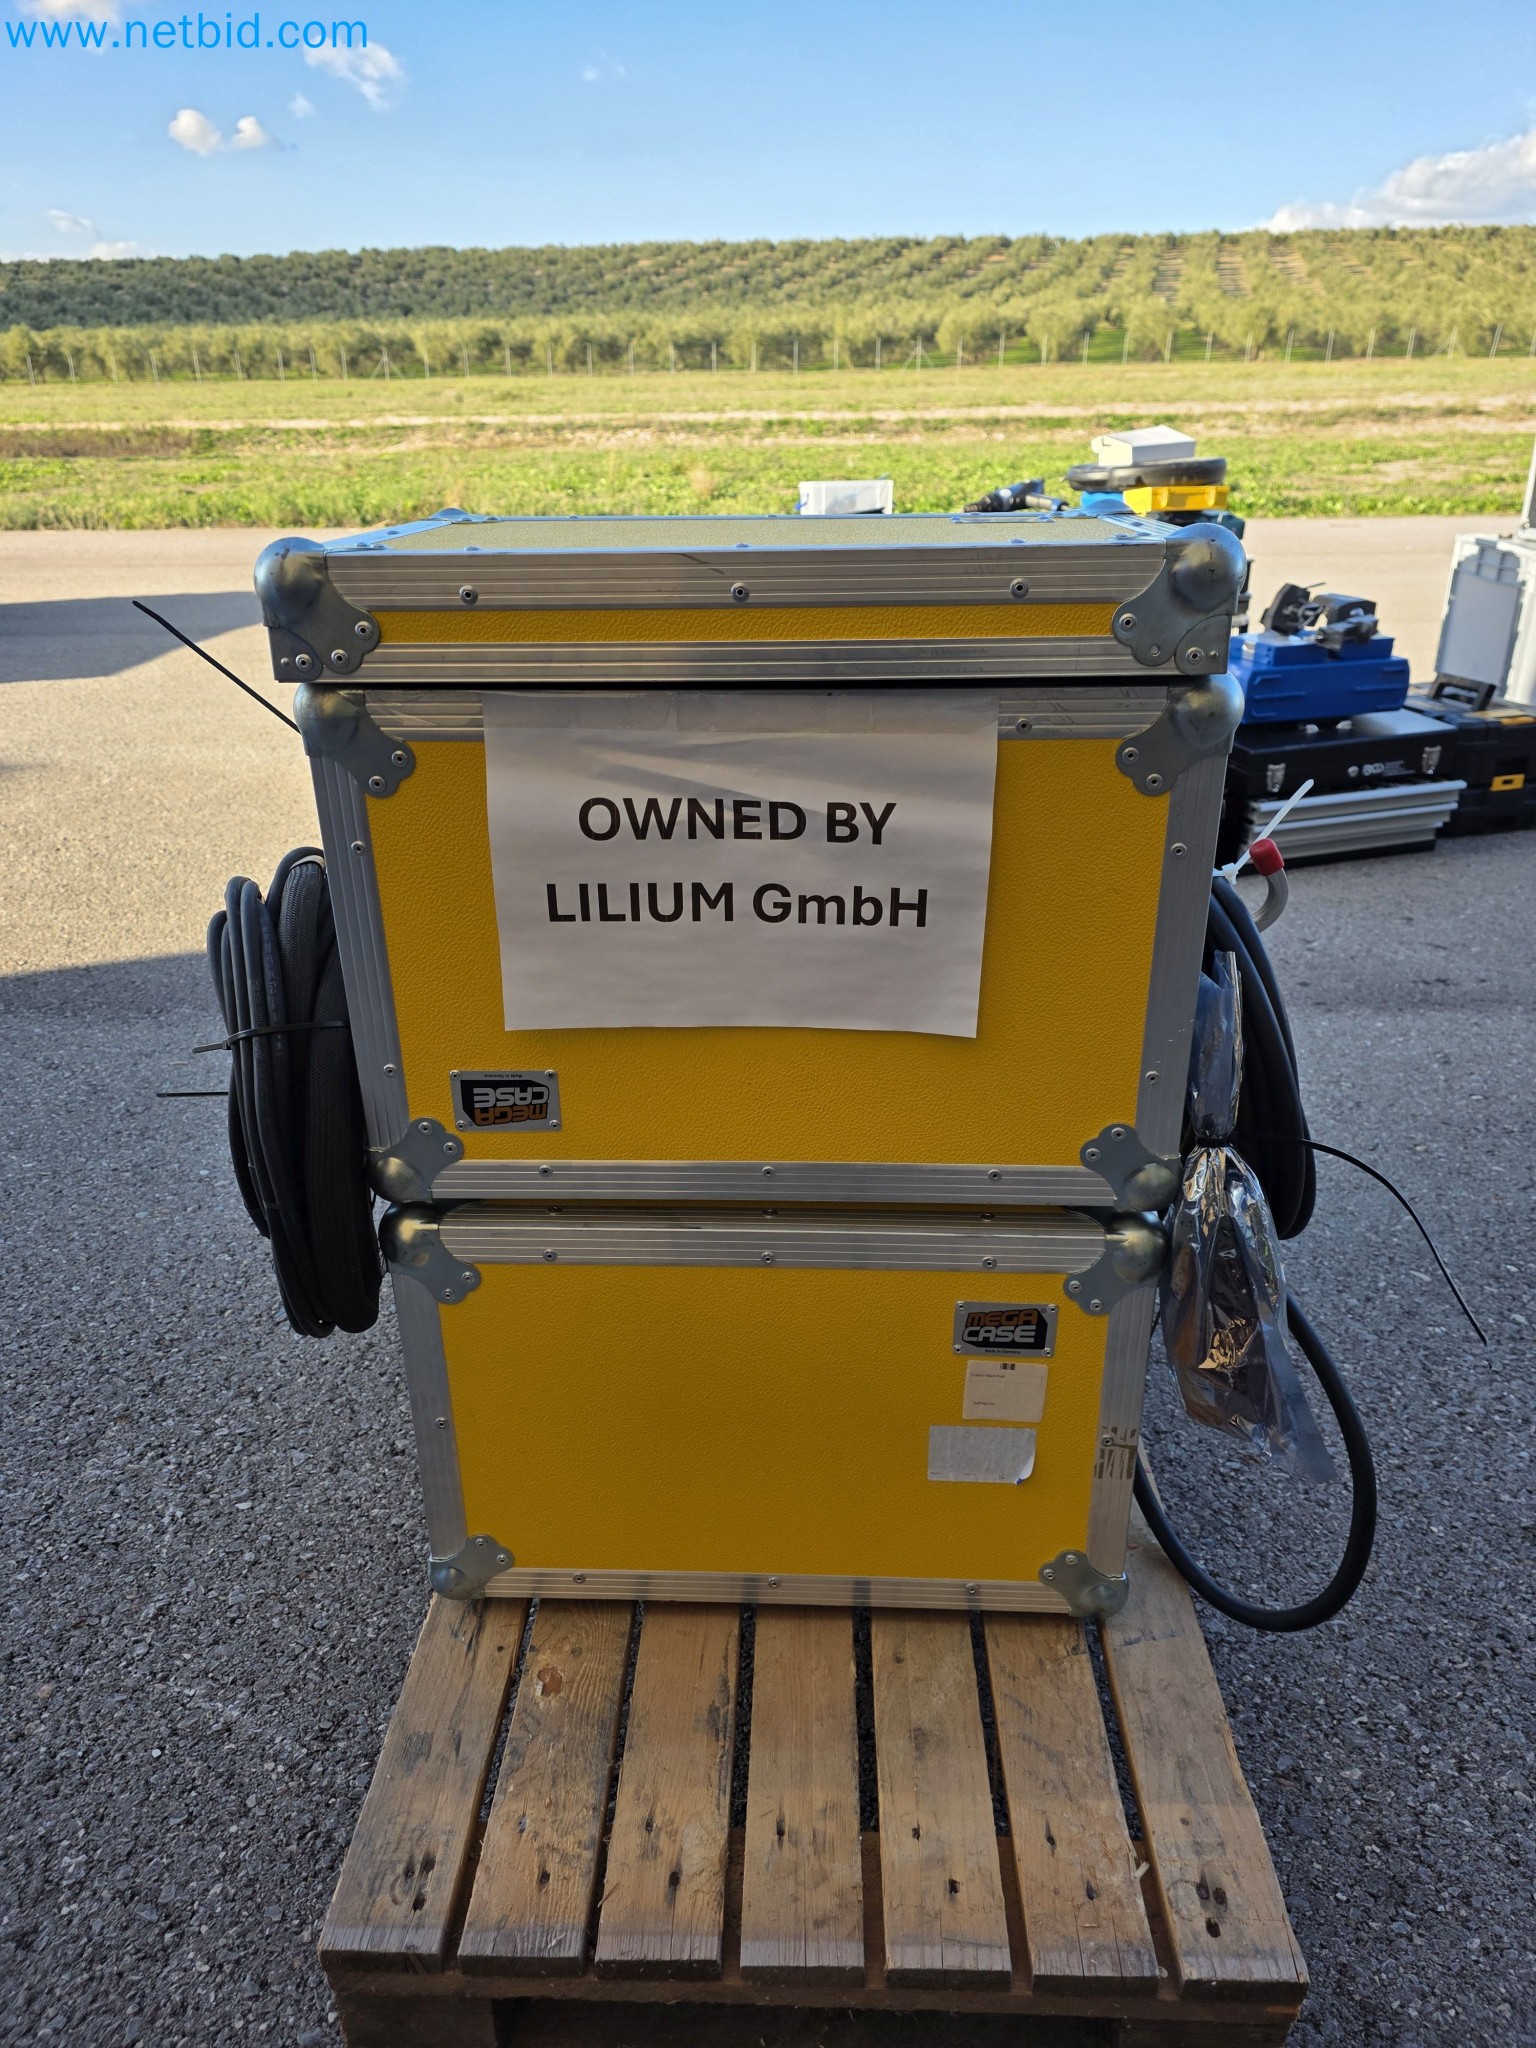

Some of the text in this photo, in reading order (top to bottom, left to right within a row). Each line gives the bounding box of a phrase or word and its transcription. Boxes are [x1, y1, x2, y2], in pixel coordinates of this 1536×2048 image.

[578, 797, 897, 845] OWNED BY
[546, 882, 928, 928] LILIUM GmbH
[473, 1087, 549, 1108] CASE
[474, 1103, 548, 1126] MEGA
[966, 1309, 1039, 1326] MEGA
[962, 1325, 1037, 1343] CASE
